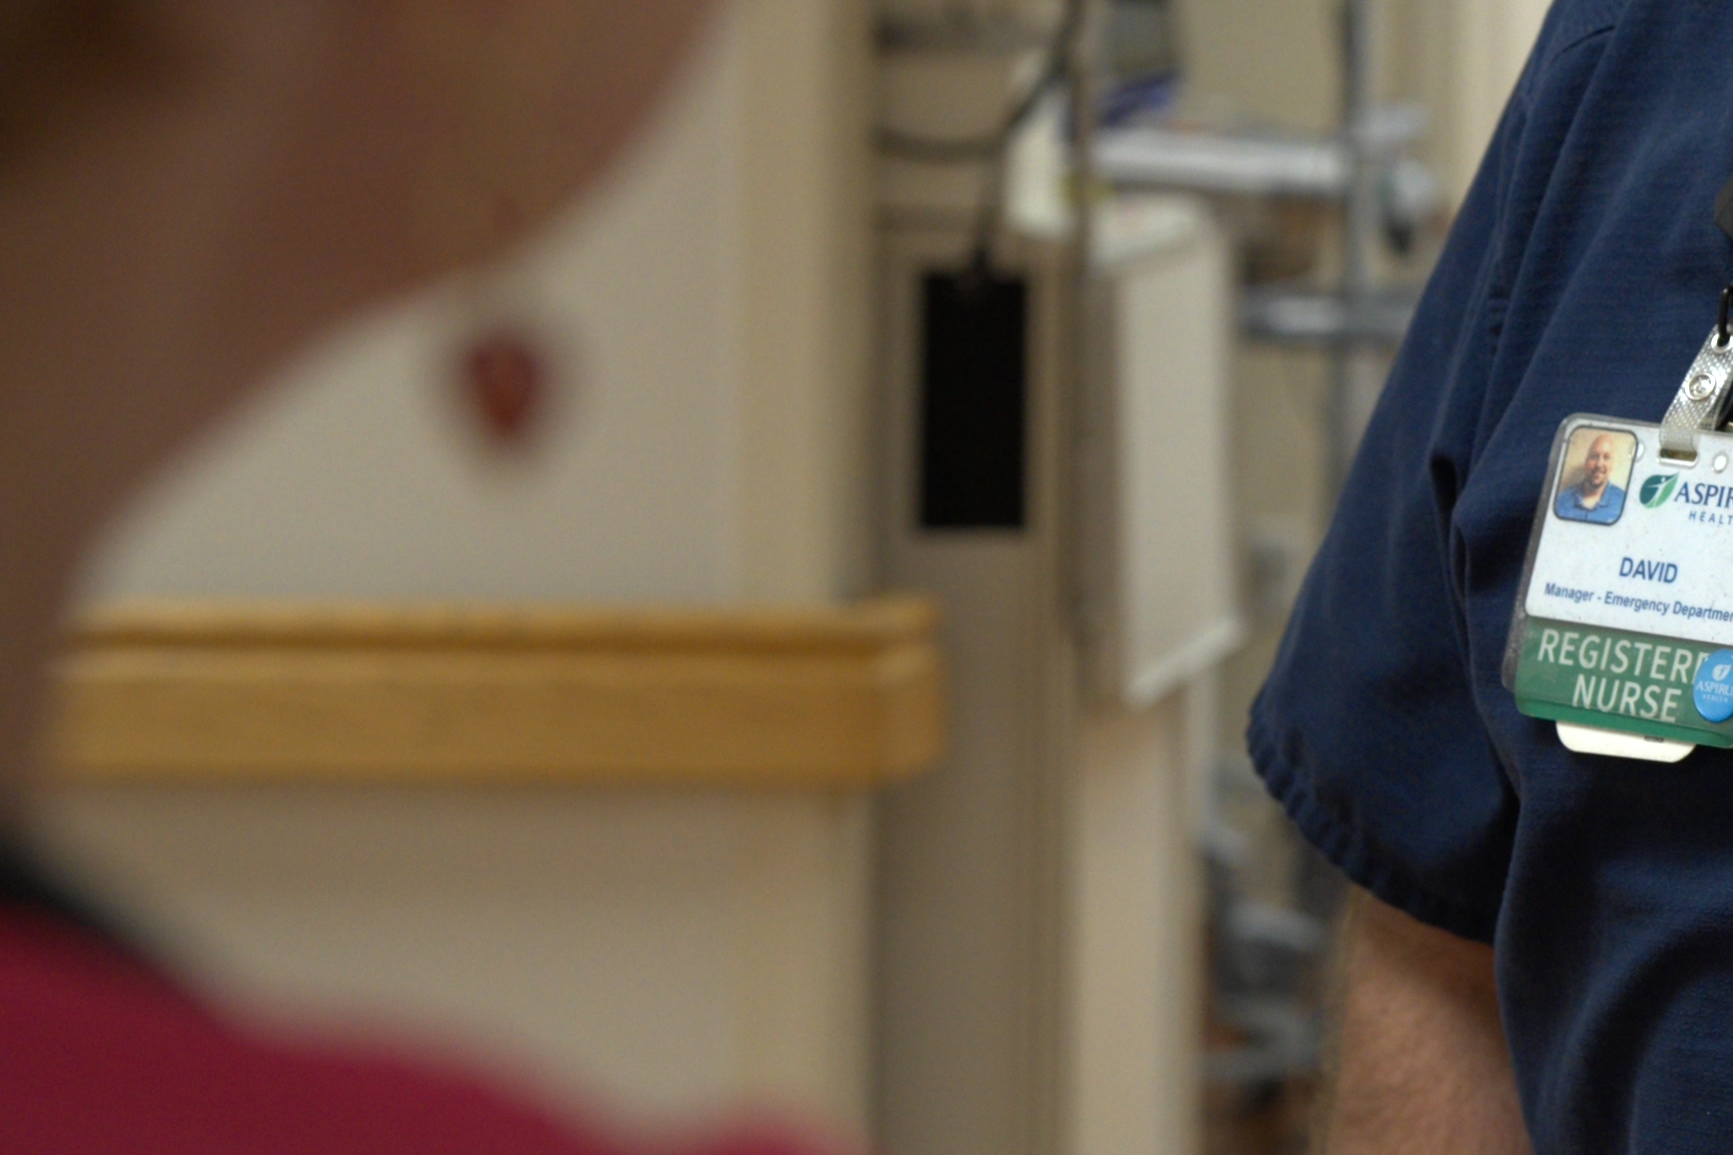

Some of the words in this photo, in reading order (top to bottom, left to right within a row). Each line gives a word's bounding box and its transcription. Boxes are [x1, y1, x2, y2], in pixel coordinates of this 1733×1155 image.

[1619, 557, 1678, 583] DAVID
[1544, 582, 1594, 603] Manager
[1604, 591, 1670, 616] Emergency
[1572, 674, 1682, 723] NURSE
